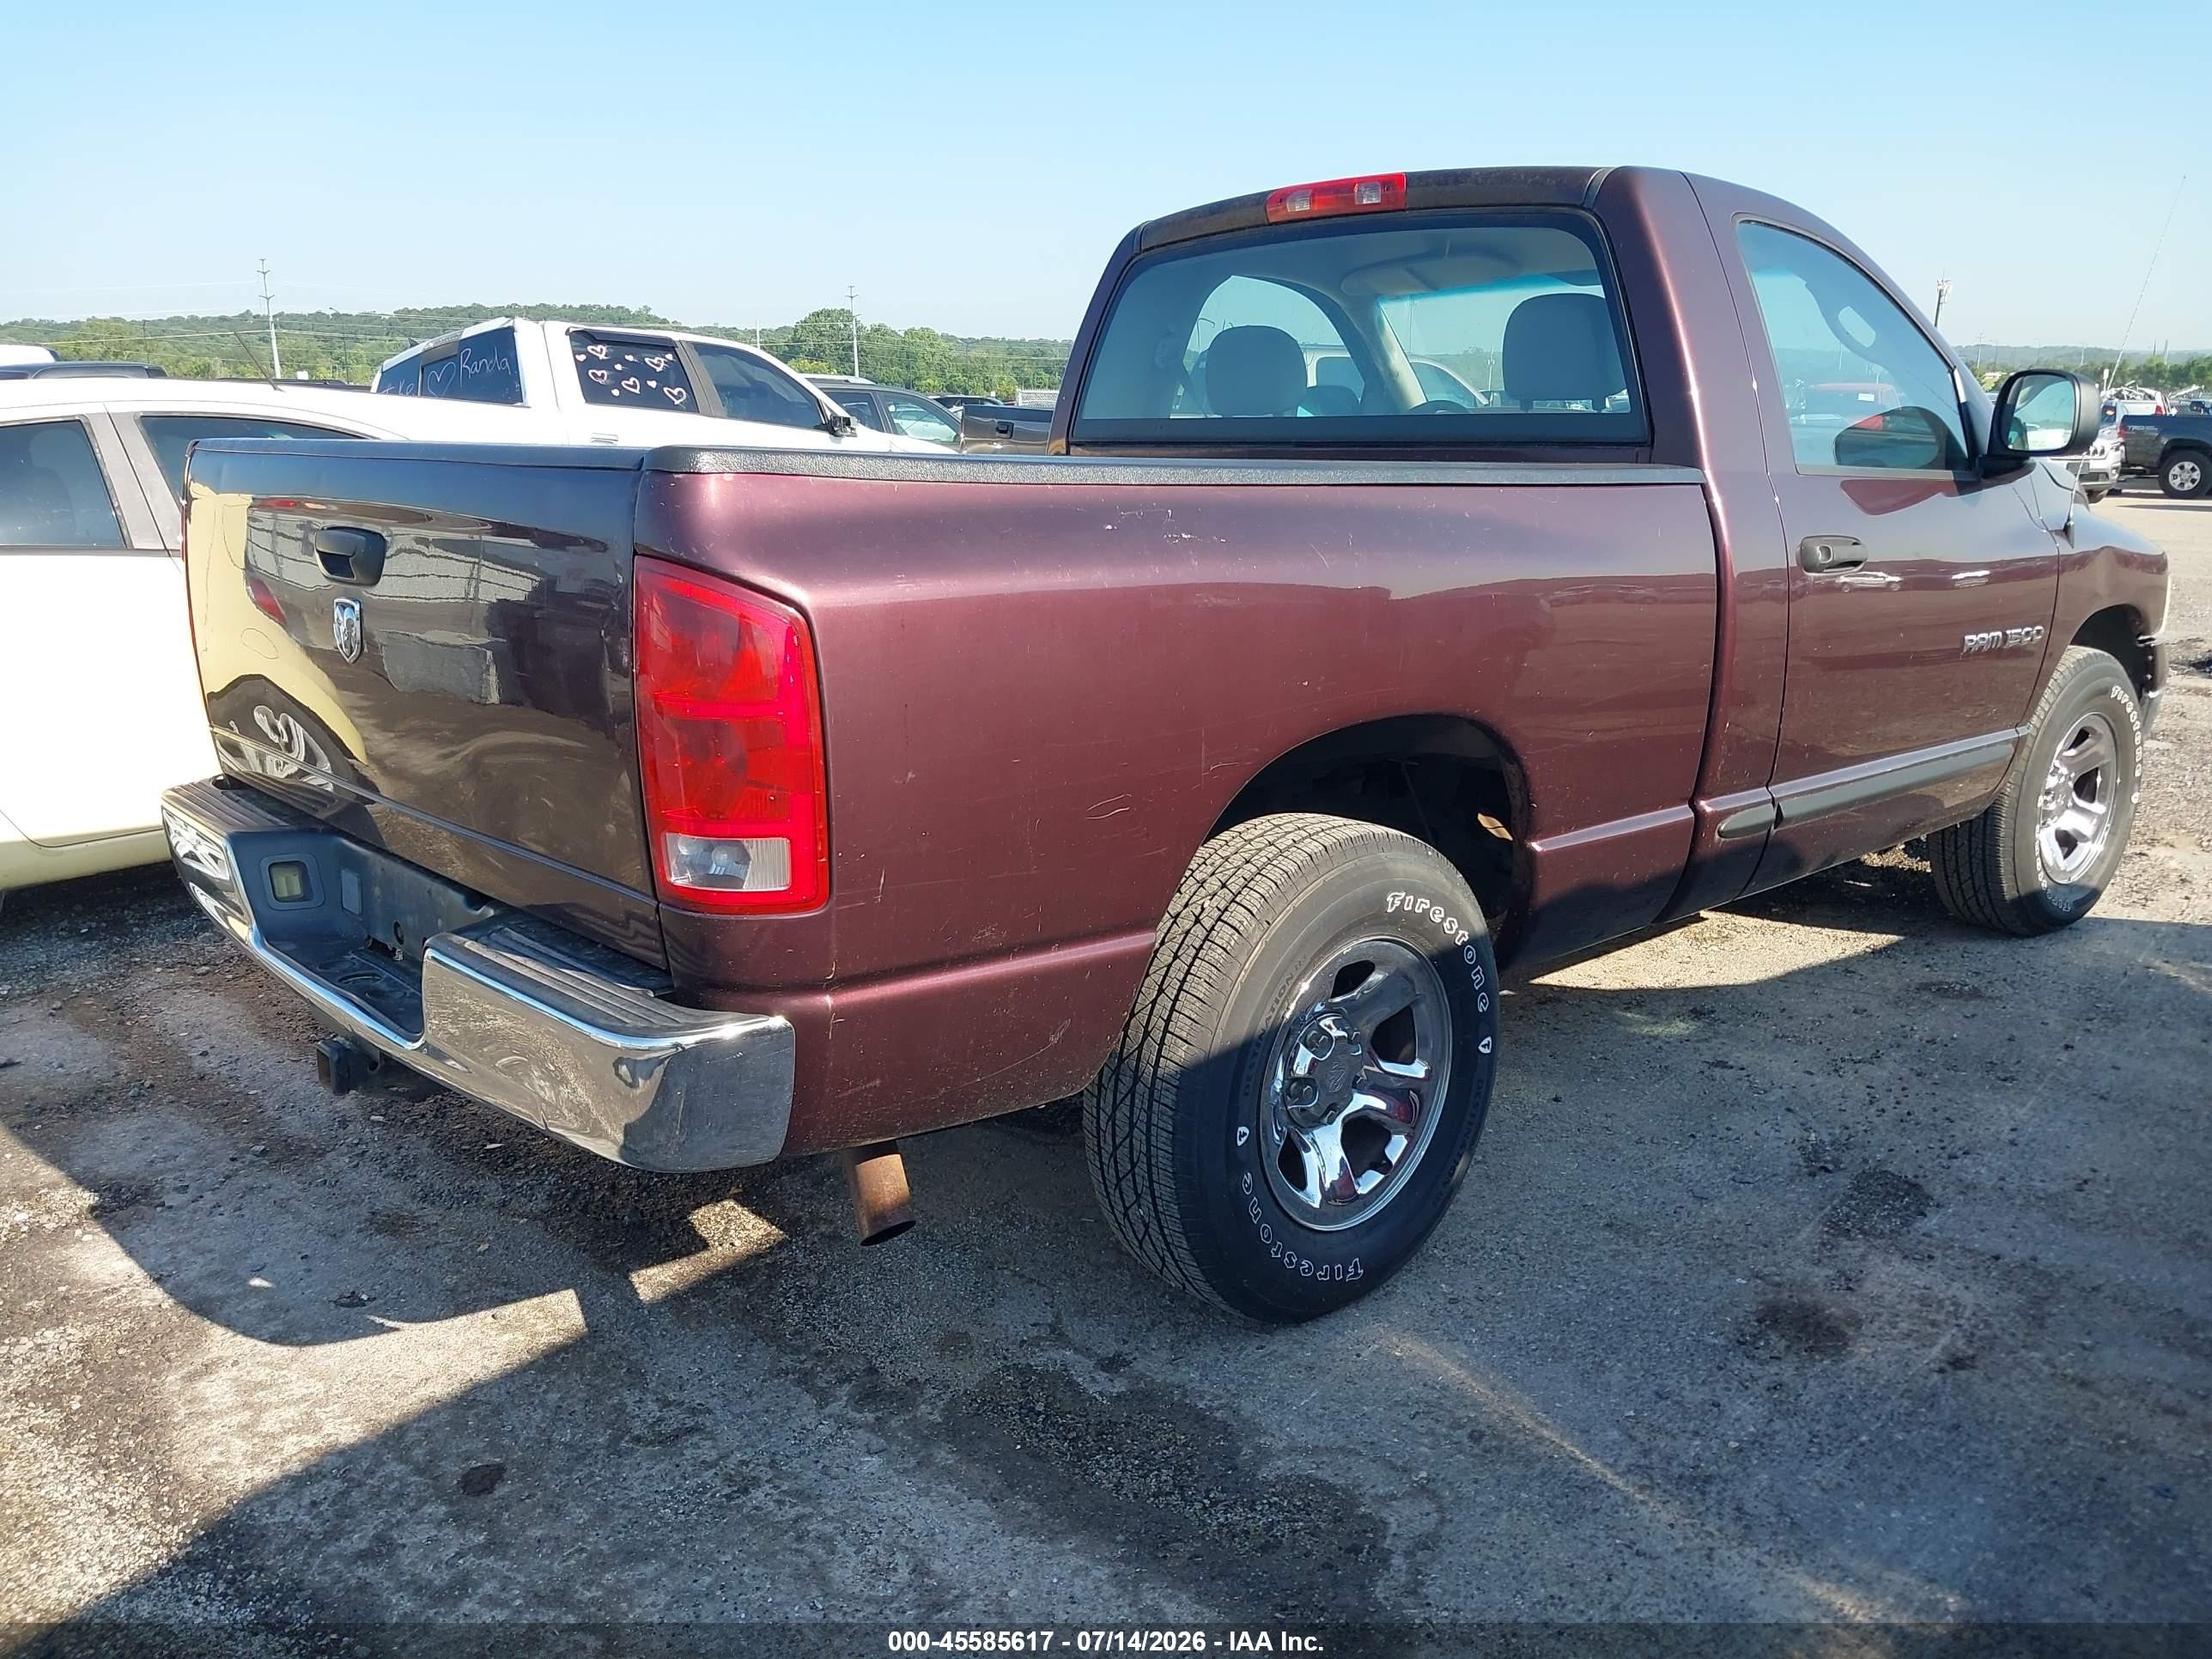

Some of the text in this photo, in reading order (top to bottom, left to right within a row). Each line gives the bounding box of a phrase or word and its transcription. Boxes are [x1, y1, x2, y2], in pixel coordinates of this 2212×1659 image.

[1963, 625, 2045, 653] RAM 1500
[1386, 891, 1490, 1013] Firestone
[1242, 1171, 1364, 1282] Firestone
